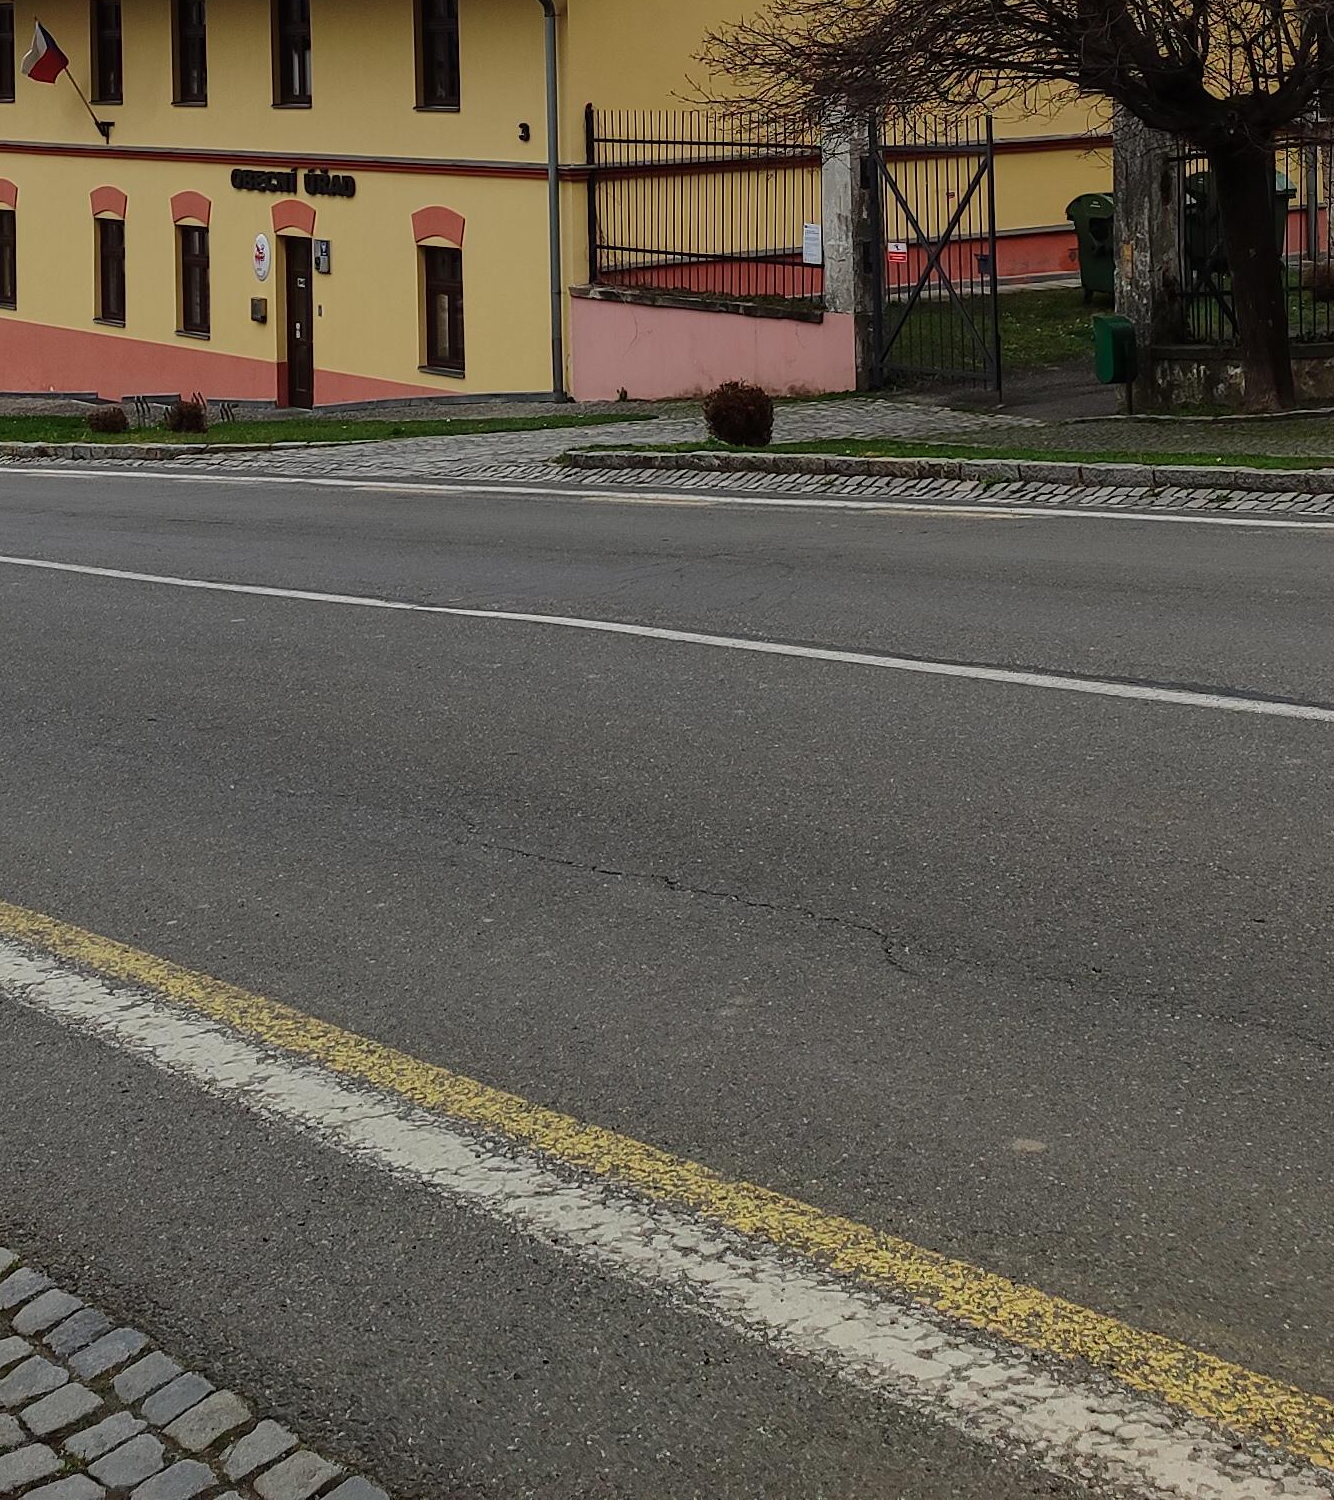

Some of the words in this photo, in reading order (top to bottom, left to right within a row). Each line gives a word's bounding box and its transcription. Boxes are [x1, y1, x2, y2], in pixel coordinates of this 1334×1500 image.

[518, 122, 531, 142] 3
[230, 167, 298, 195] OBECNÍ
[304, 166, 356, 198] ÚŘAD
